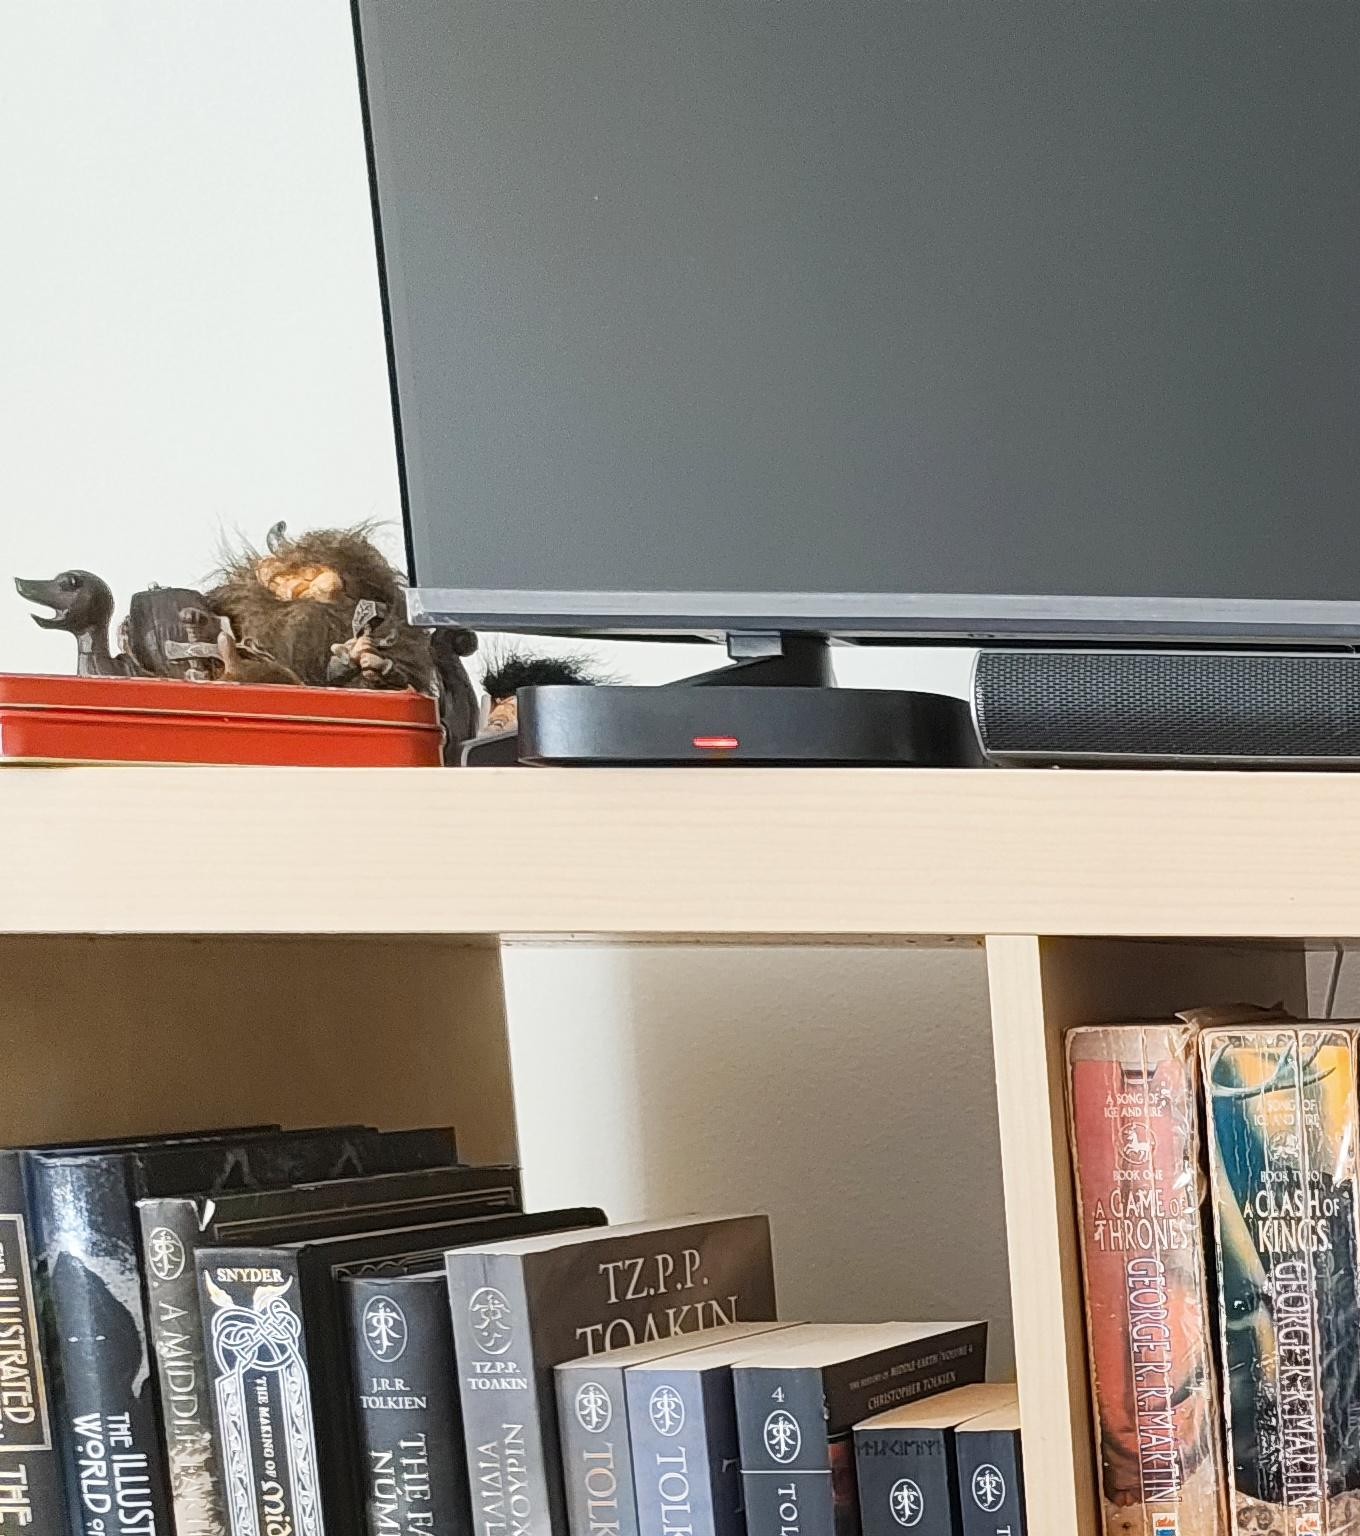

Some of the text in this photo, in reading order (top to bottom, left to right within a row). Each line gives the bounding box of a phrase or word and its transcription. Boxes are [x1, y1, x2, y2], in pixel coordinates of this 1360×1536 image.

[216, 1268, 284, 1283] SNYDER
[360, 1395, 426, 1409] TOLKIEN
[106, 1412, 130, 1447] THE
[72, 1413, 111, 1514] WORLD
